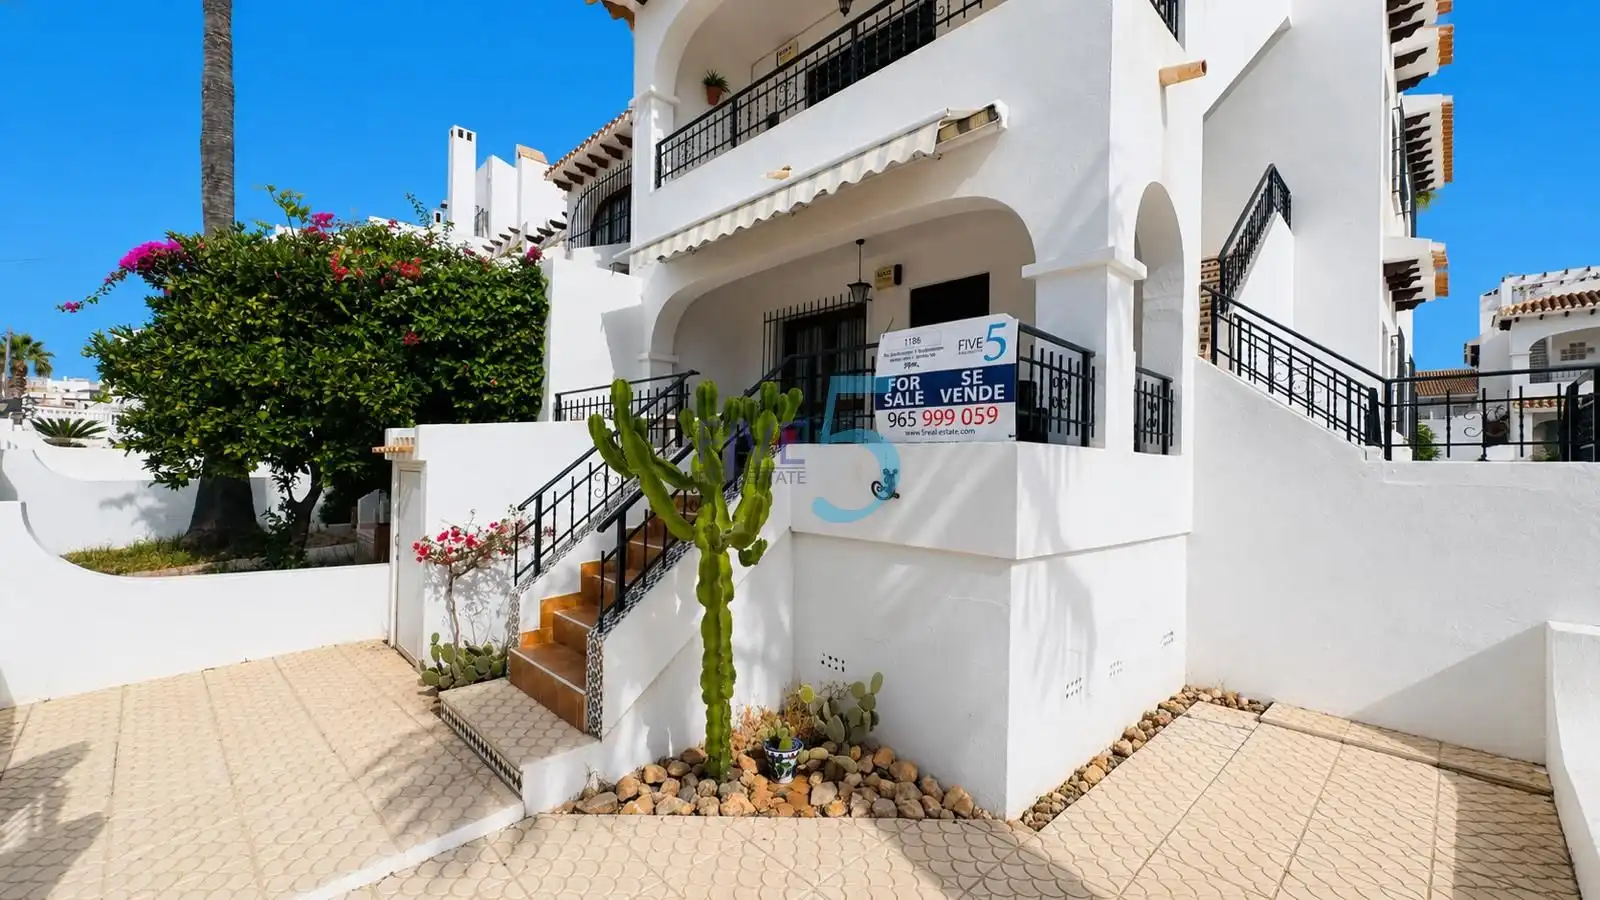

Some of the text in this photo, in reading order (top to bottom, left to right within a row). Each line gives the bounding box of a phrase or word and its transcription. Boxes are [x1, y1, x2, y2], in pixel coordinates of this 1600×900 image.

[904, 336, 921, 346] 1186
[958, 322, 1007, 362] FIVE 5
[888, 376, 920, 392] FOR
[961, 369, 983, 386] SE
[884, 391, 924, 407] SALE
[940, 384, 1005, 403] VENDE
[887, 406, 998, 428] 965 999 059
